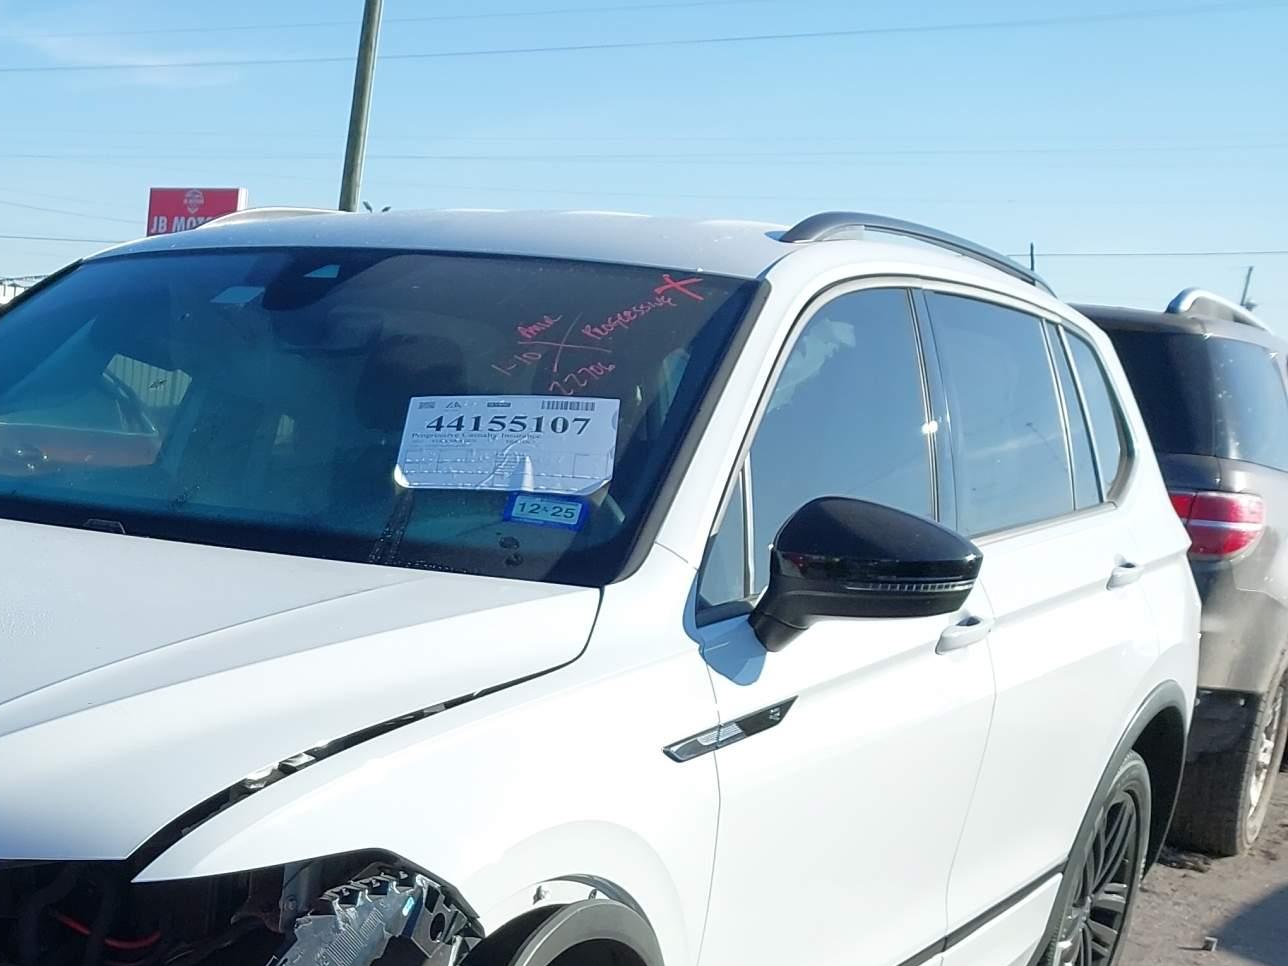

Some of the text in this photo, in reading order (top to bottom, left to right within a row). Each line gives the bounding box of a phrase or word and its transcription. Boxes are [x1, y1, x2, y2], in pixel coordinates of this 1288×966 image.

[151, 216, 215, 233] JB MOT
[426, 415, 592, 435] 44155107
